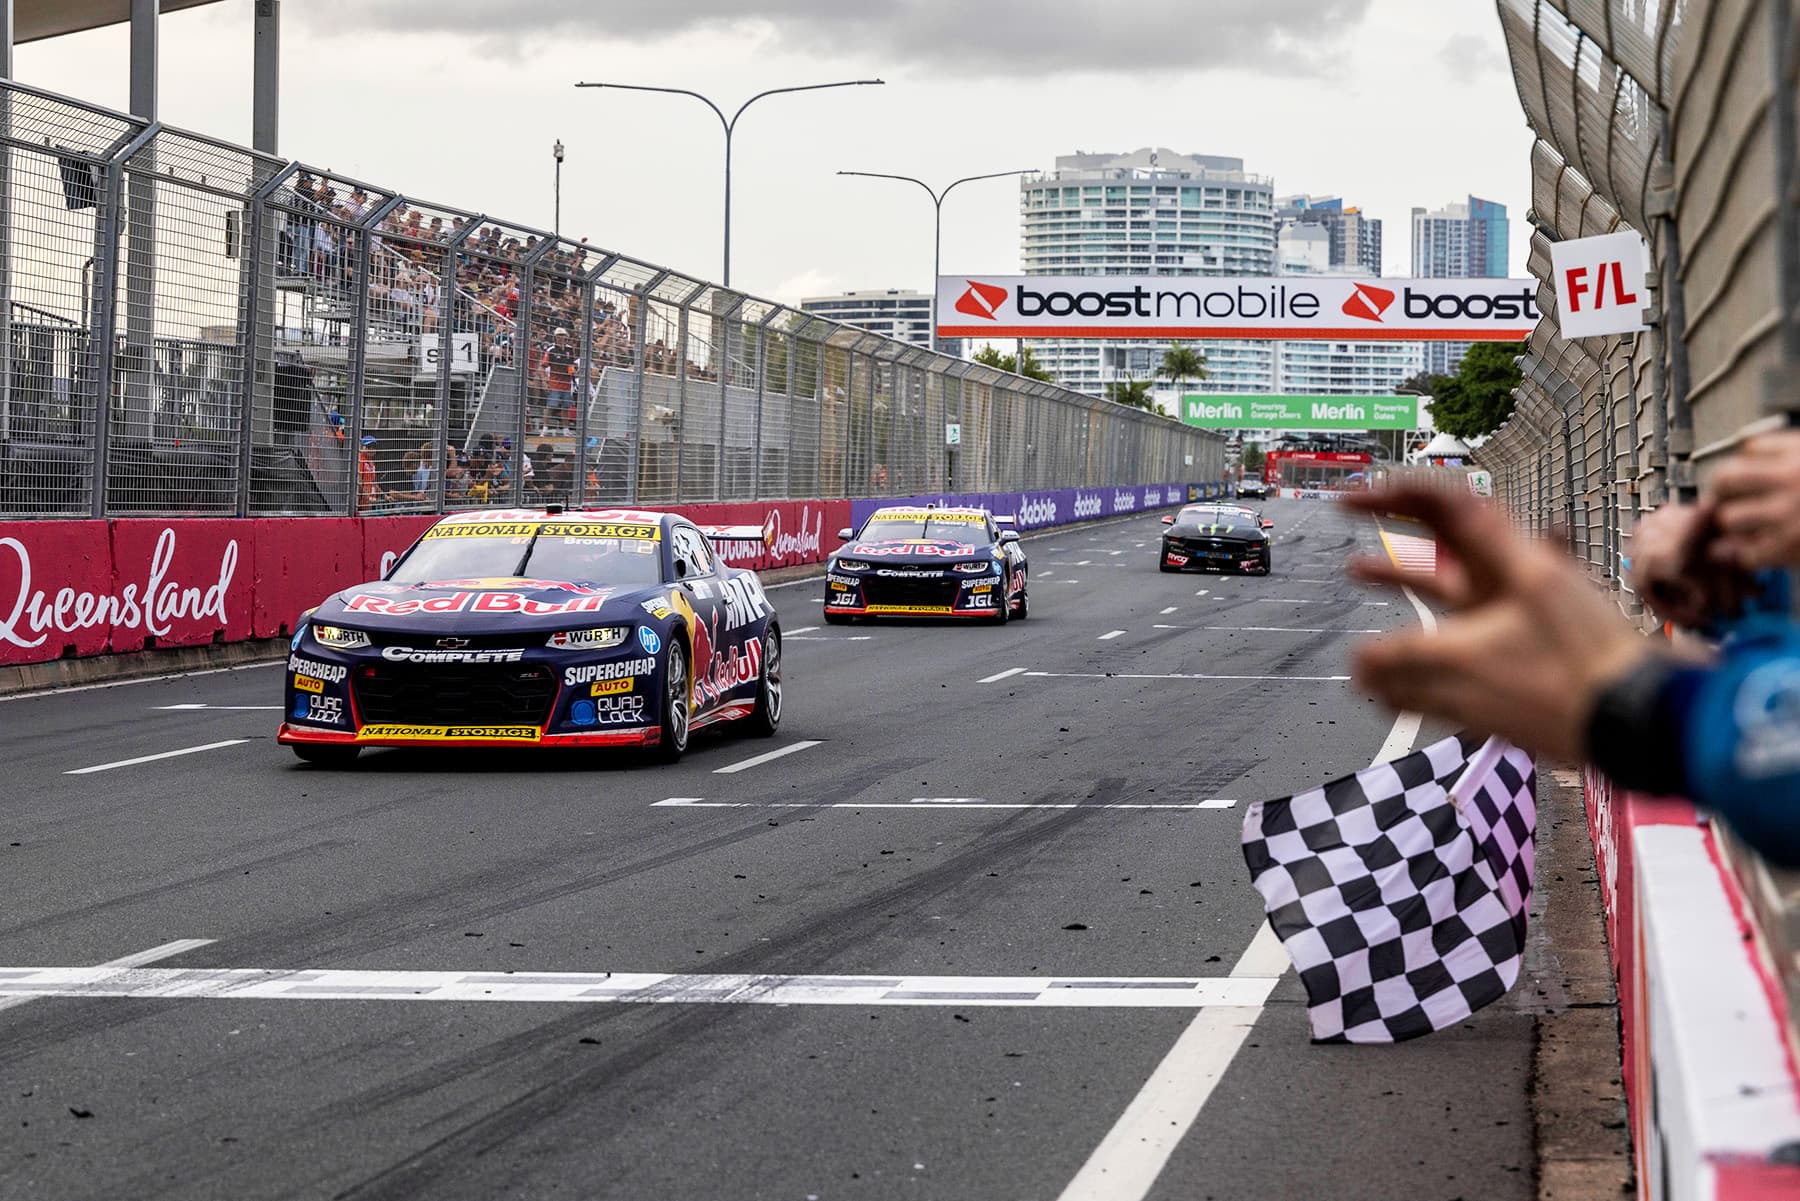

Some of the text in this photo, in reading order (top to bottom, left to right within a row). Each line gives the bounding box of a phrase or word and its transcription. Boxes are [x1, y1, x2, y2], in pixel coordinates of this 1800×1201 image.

[1566, 261, 1637, 313] F/L
[1403, 287, 1539, 321] boost
[1189, 402, 1243, 420] Merlin
[1250, 402, 1287, 412] Powering
[1311, 403, 1365, 421] Merlin
[1374, 403, 1410, 414] Powering
[1250, 411, 1277, 421] Garage
[1374, 412, 1395, 421] Gates
[1018, 494, 1057, 526] dabble
[1073, 491, 1101, 518] dabble
[432, 523, 652, 538] NATIONAL STORAGE
[768, 504, 822, 561] Queensland
[563, 538, 619, 547] Brown
[853, 544, 976, 557] Red Bull
[342, 592, 608, 617] Red Bull
[569, 627, 621, 643] WÜRTH
[643, 630, 657, 651] hp
[381, 646, 523, 663] COMPLETE
[564, 657, 656, 687] SUPERCHEAP
[296, 676, 322, 691] AUTO
[595, 681, 630, 693] AUTO
[597, 695, 644, 712] QUAD
[598, 709, 645, 724] LOCK
[362, 726, 532, 738] NATIONAL STORAGE
